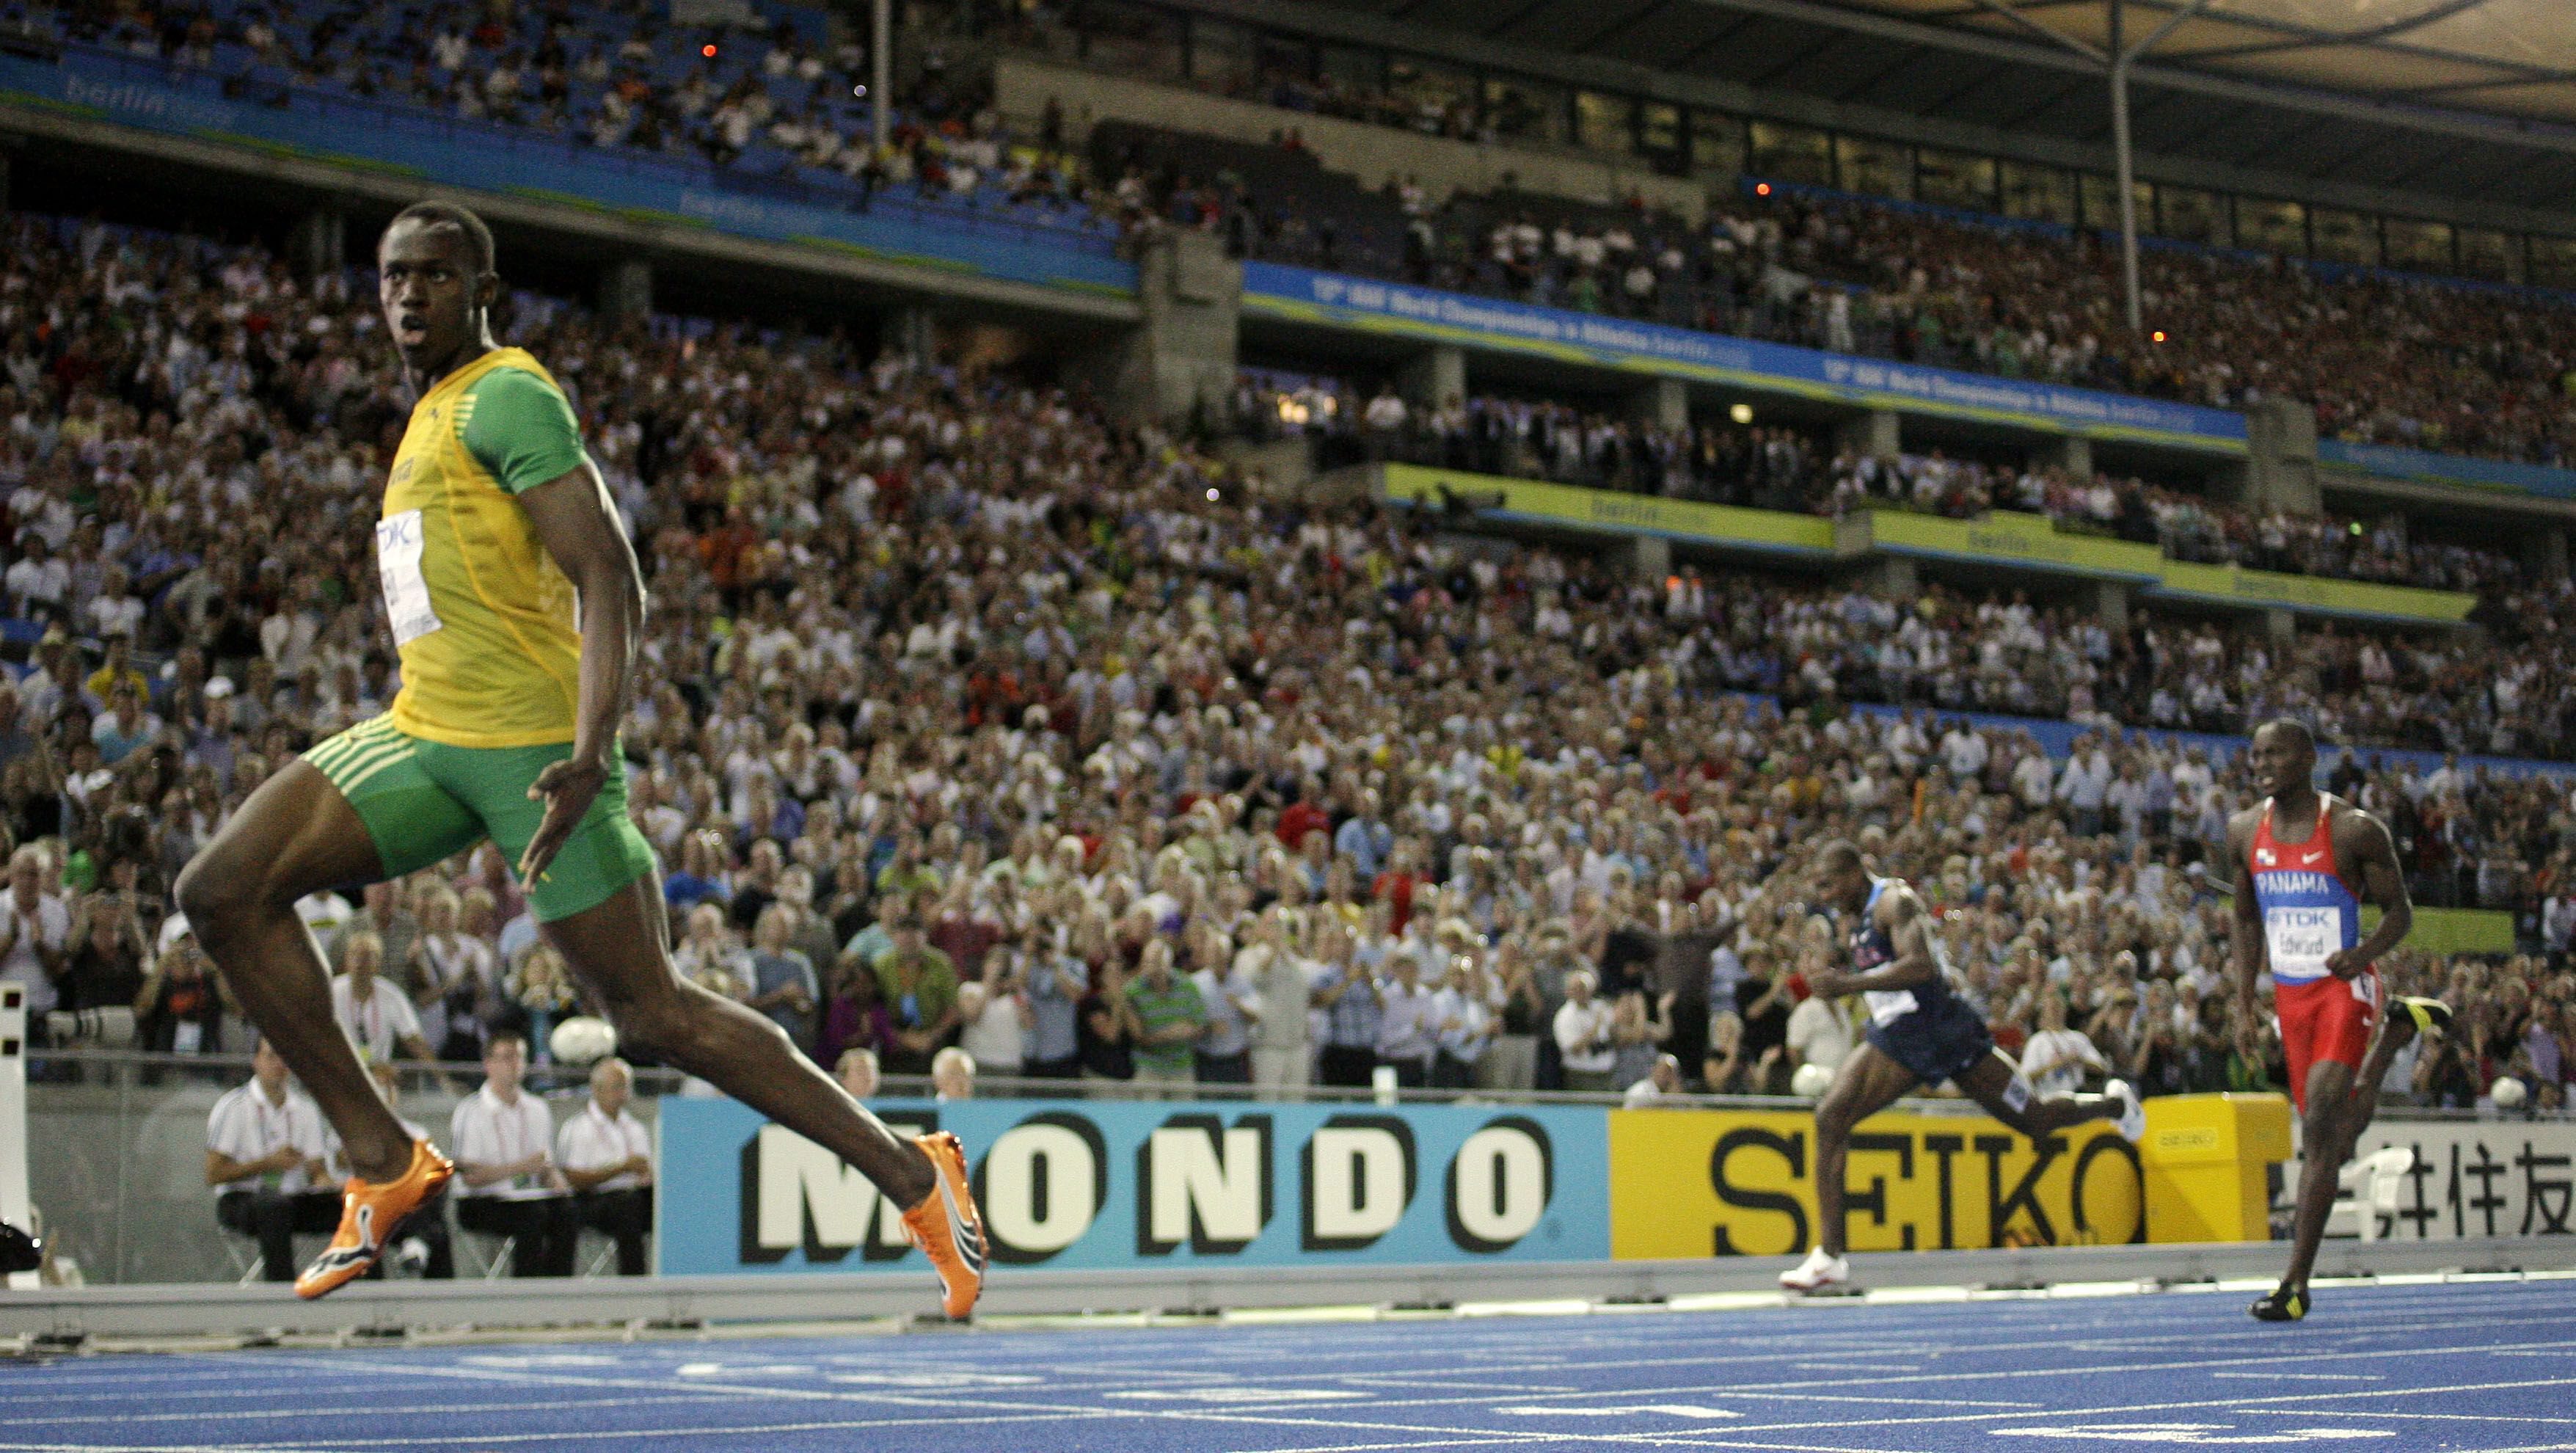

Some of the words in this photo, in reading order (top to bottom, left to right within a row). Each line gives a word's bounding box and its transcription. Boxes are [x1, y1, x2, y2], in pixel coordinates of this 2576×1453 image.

[2257, 872, 2329, 895] PANAMA
[2284, 912, 2330, 928] TDK
[740, 1110, 1554, 1264] MONDO
[1710, 1125, 2148, 1257] SEIKO
